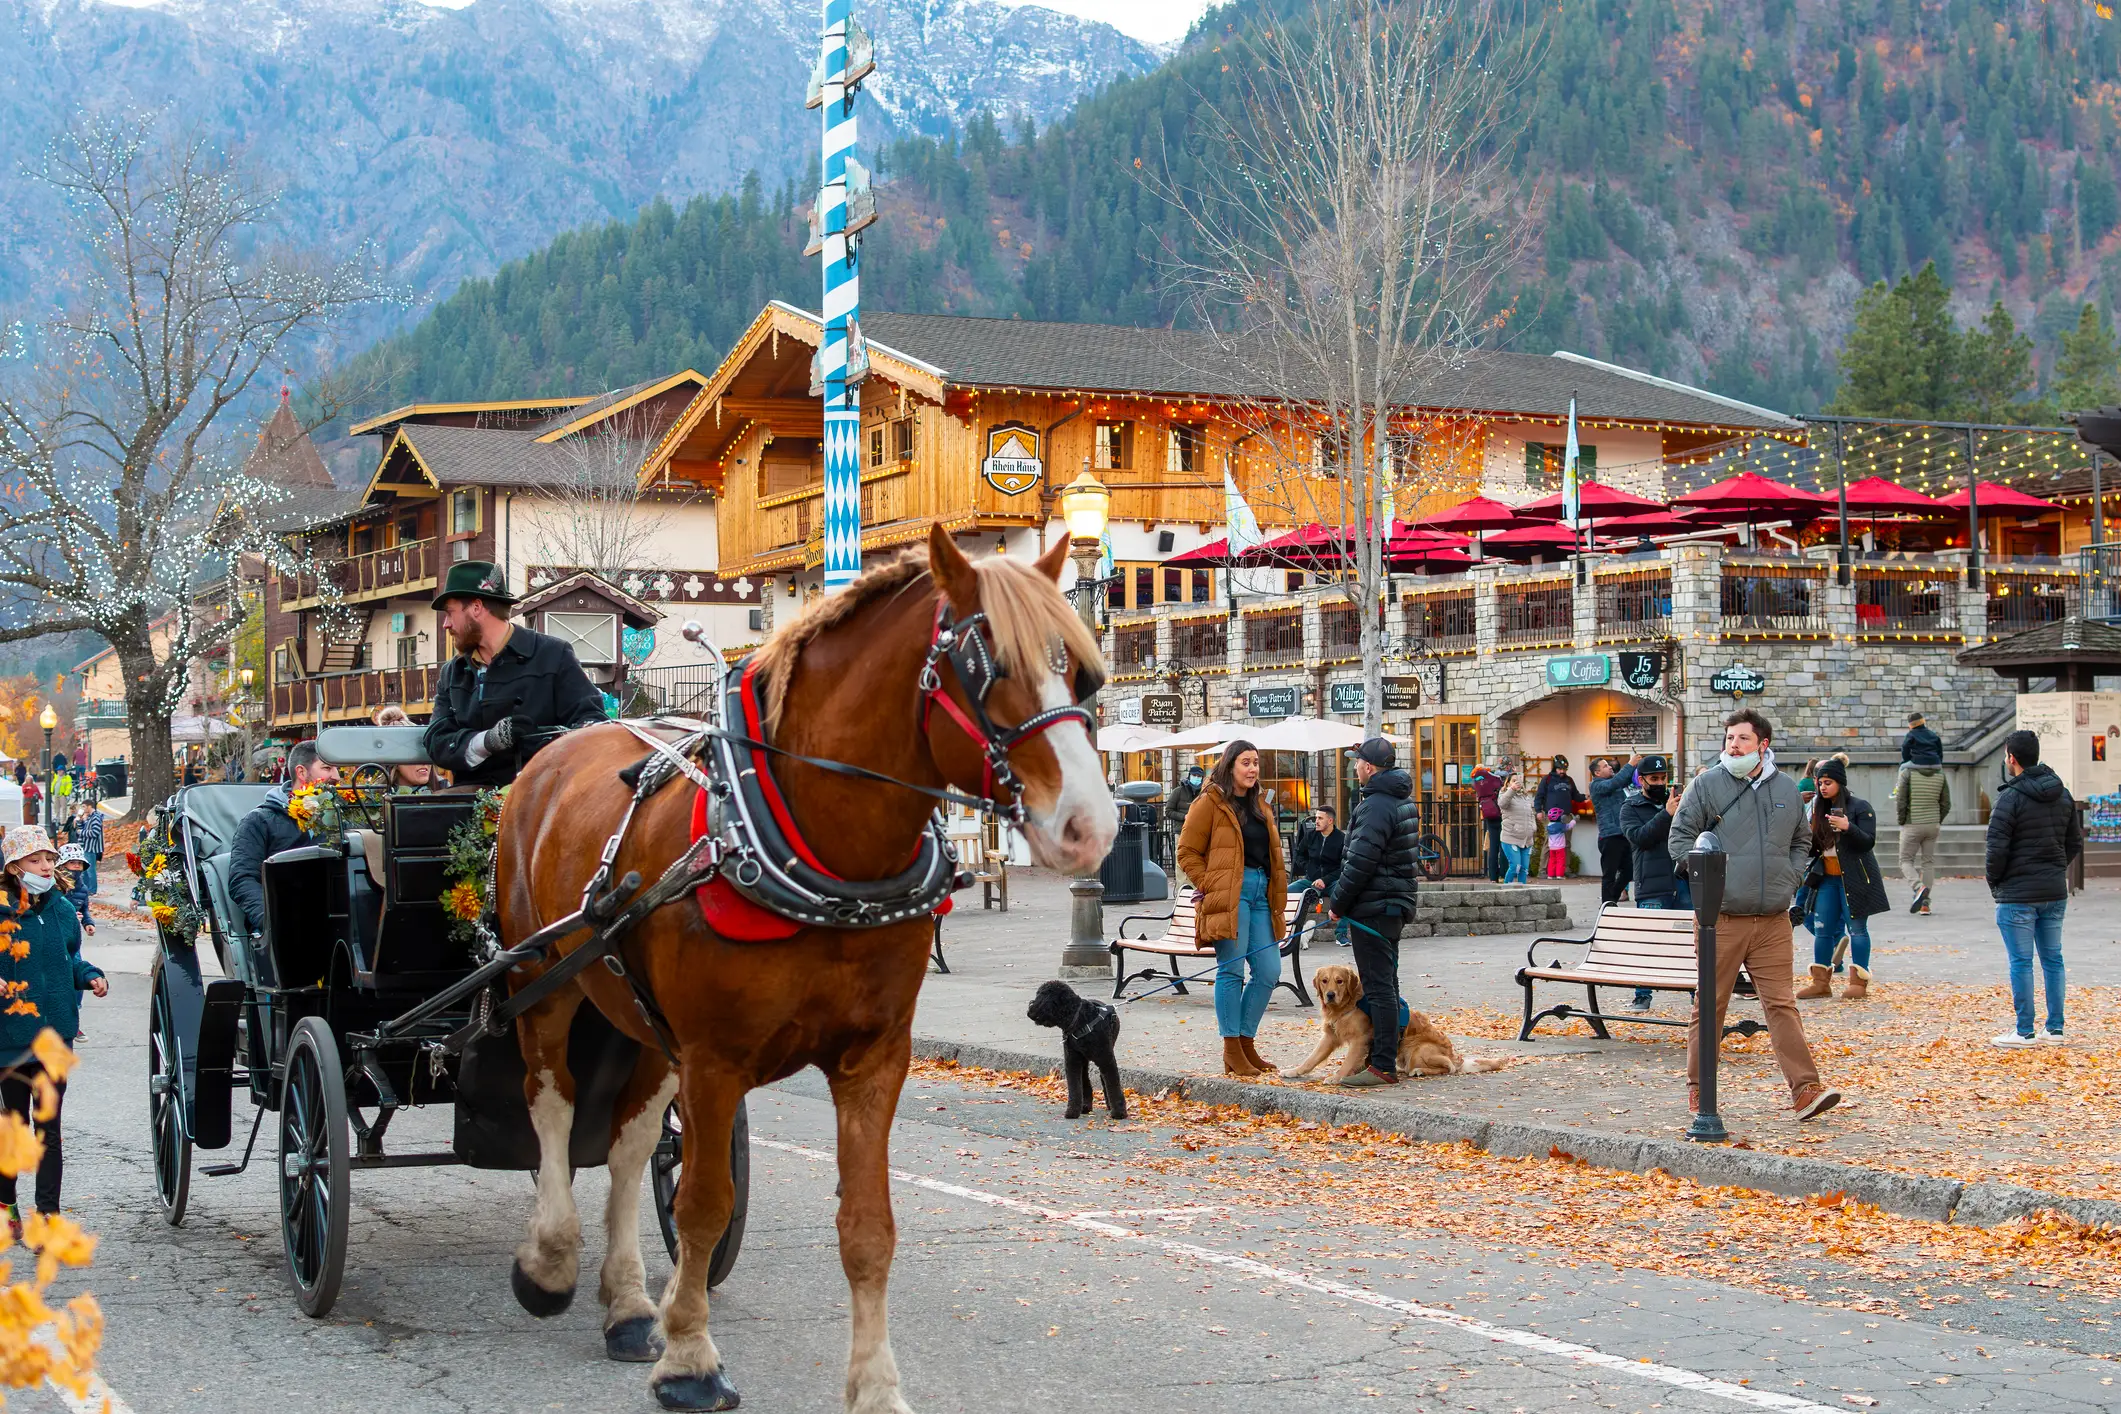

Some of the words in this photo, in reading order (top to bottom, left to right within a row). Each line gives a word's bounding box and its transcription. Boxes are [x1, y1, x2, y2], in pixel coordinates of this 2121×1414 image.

[381, 555, 401, 575] Hoel
[1571, 660, 1601, 680] Coffee
[1634, 655, 1652, 673] J5
[1629, 672, 1655, 686] Coffee
[1714, 679, 1757, 690] UPSTAIRS
[1251, 694, 1269, 707] Ryan
[1269, 690, 1292, 703] Patrick
[1335, 684, 1364, 701] Milbra
[1148, 707, 1176, 716] Patrick
[1151, 699, 1173, 709] Ryan
